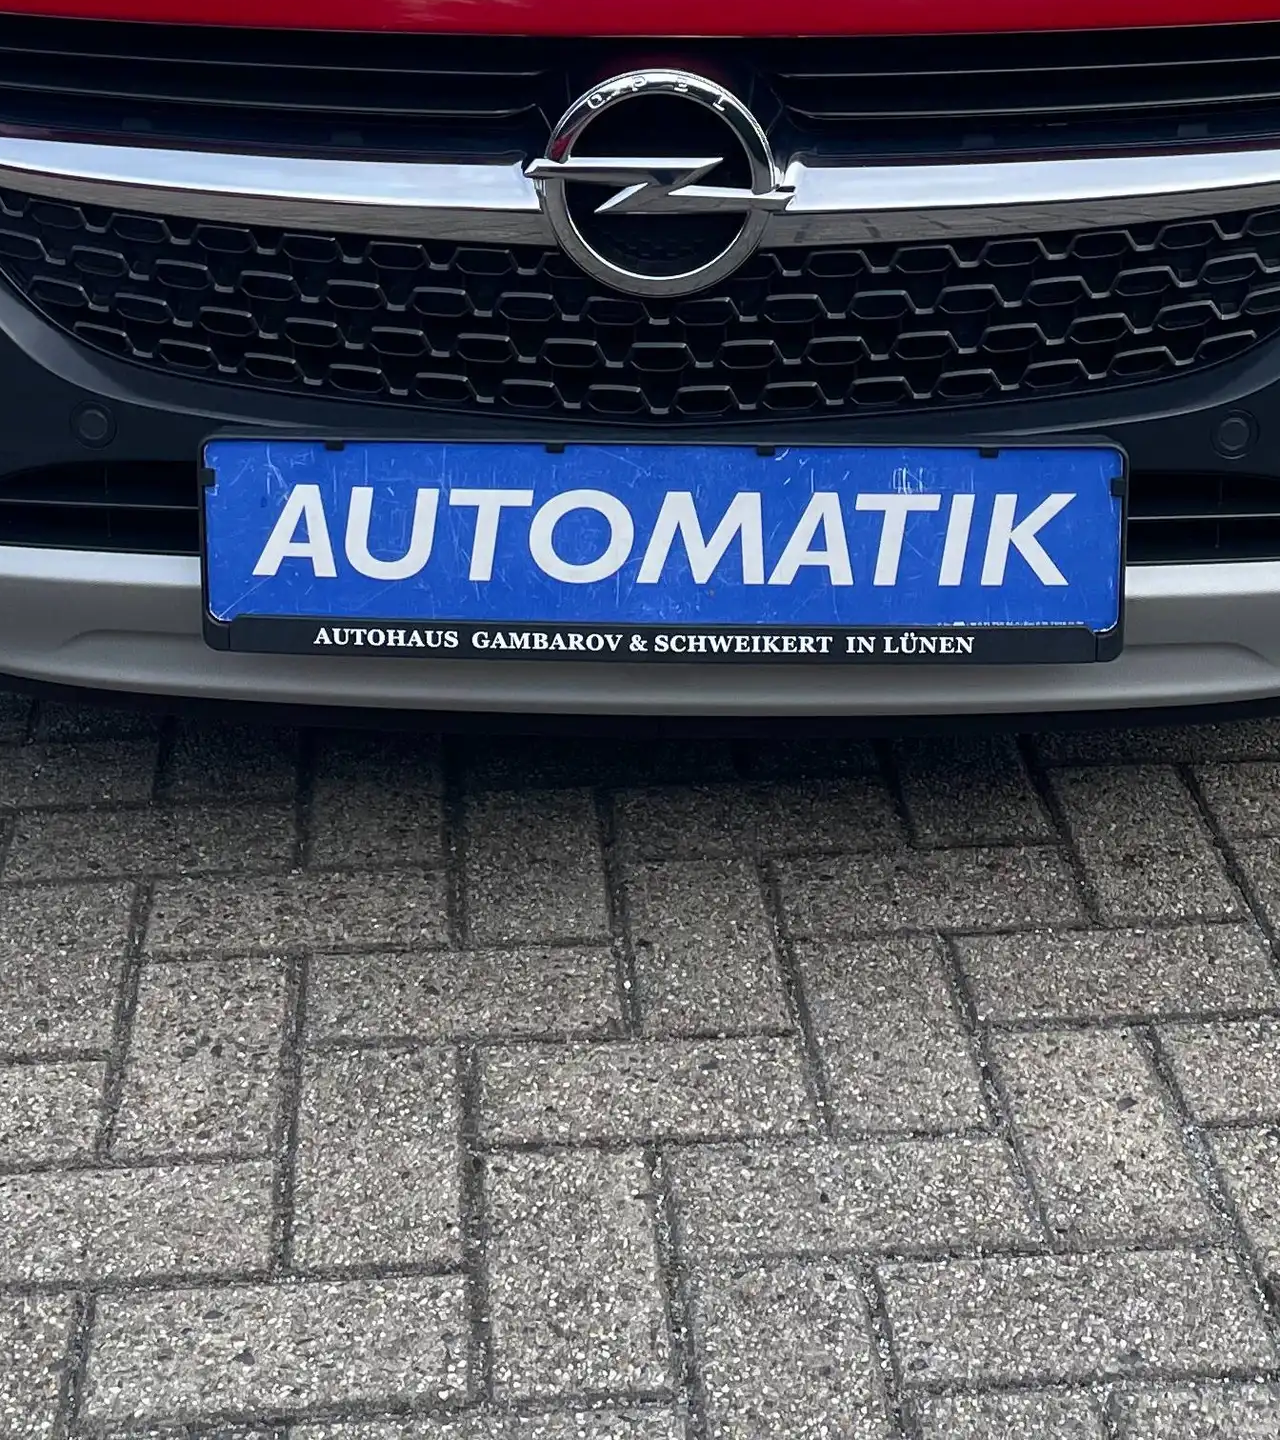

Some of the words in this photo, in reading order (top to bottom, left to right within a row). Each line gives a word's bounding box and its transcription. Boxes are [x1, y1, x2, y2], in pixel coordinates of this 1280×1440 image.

[586, 75, 727, 113] OPEL
[253, 484, 1077, 586] AUTOMATIK
[313, 627, 459, 650] AUTOHAUS
[471, 631, 624, 653] GAMBAROV
[629, 634, 649, 652] &
[654, 634, 833, 654] SCHWEIKERT
[845, 636, 877, 654] IN
[883, 631, 975, 654] LÜNEN
